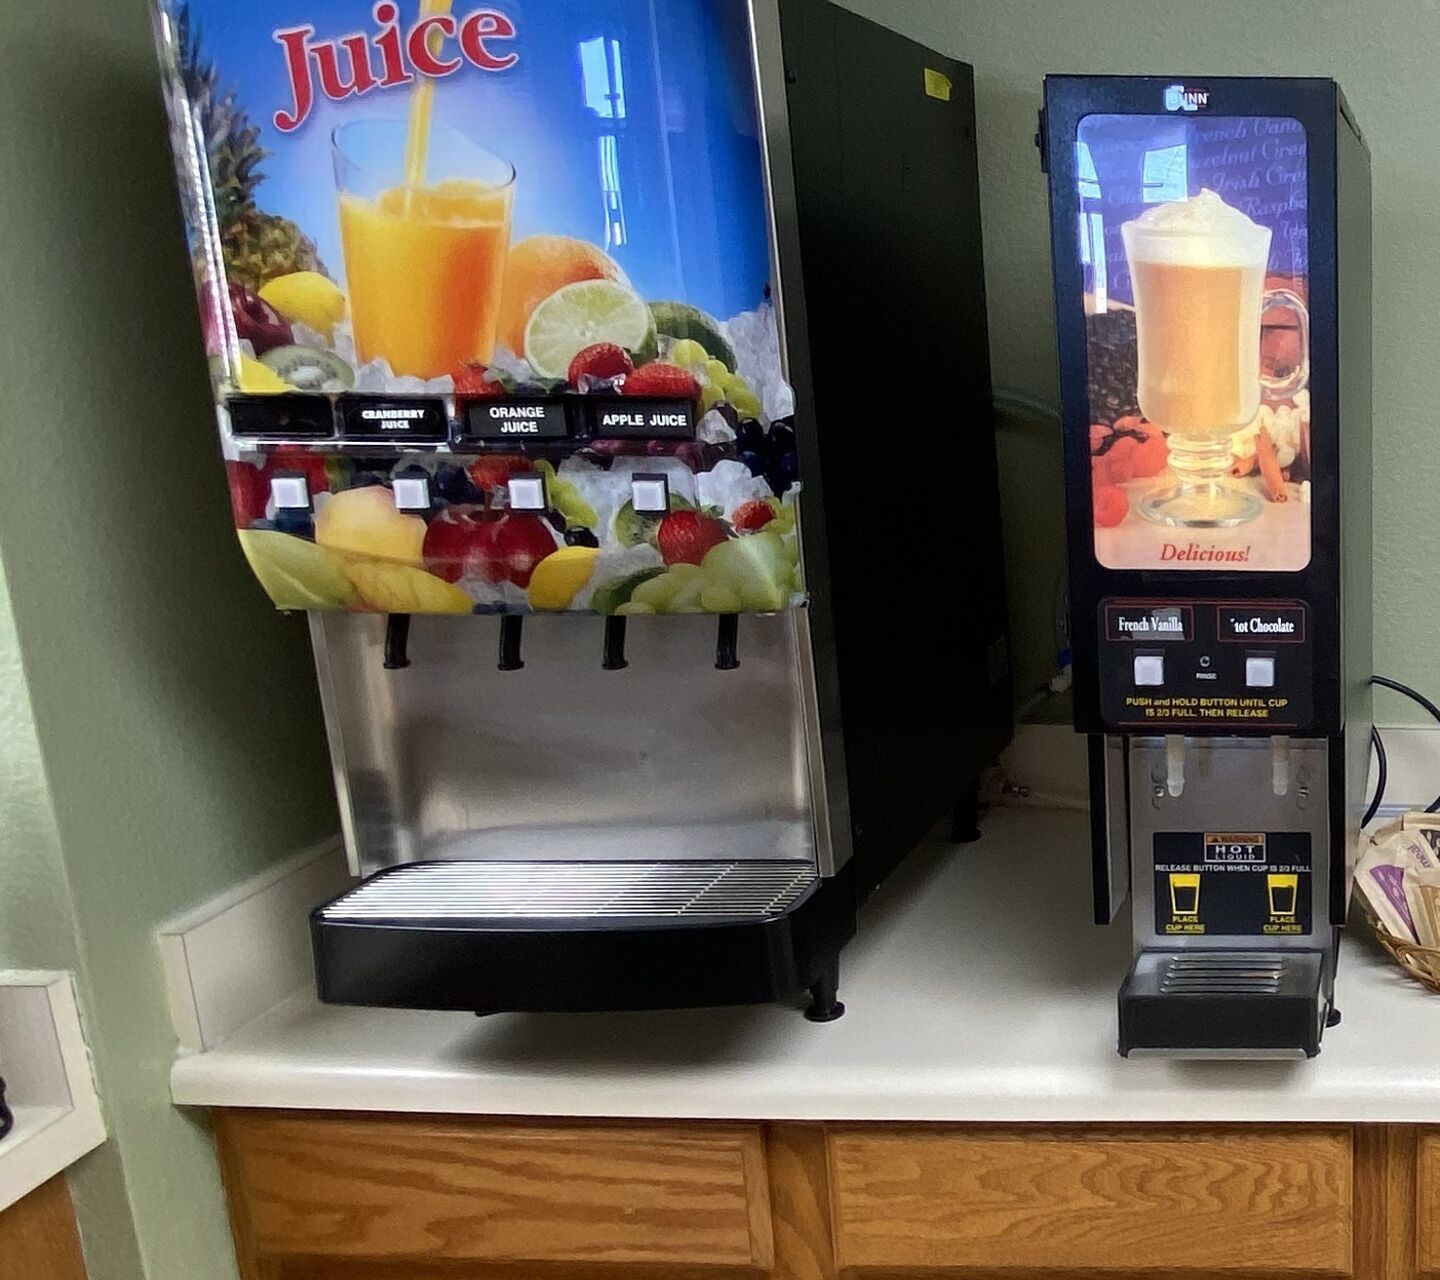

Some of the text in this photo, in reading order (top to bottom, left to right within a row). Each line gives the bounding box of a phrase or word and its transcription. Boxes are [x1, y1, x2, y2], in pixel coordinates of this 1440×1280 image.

[273, 0, 519, 132] Juice
[361, 409, 425, 419] CRANBERRY
[489, 407, 545, 418] ORANGE
[381, 420, 410, 429] JUICE
[602, 414, 687, 426] APPLE JUICE
[500, 421, 539, 433] JUICE
[1159, 542, 1251, 562] Delicious!
[1118, 616, 1184, 632] French Vanilla
[1249, 618, 1295, 633] Chocolate
[1126, 697, 1288, 707] PUSH and HOLD BUTTON UNTIL CUP
[1146, 709, 1155, 717] IS
[1156, 709, 1170, 717] 2/3
[1200, 709, 1224, 717] THEN
[1226, 709, 1269, 718] RELEASE
[1215, 845, 1255, 854] HOT
[1155, 864, 1191, 872] RELEASE
[1193, 864, 1225, 872] BUTTON
[1226, 864, 1250, 872] WHEN
[1251, 864, 1269, 872] CUP
[1291, 864, 1311, 872] FULL
